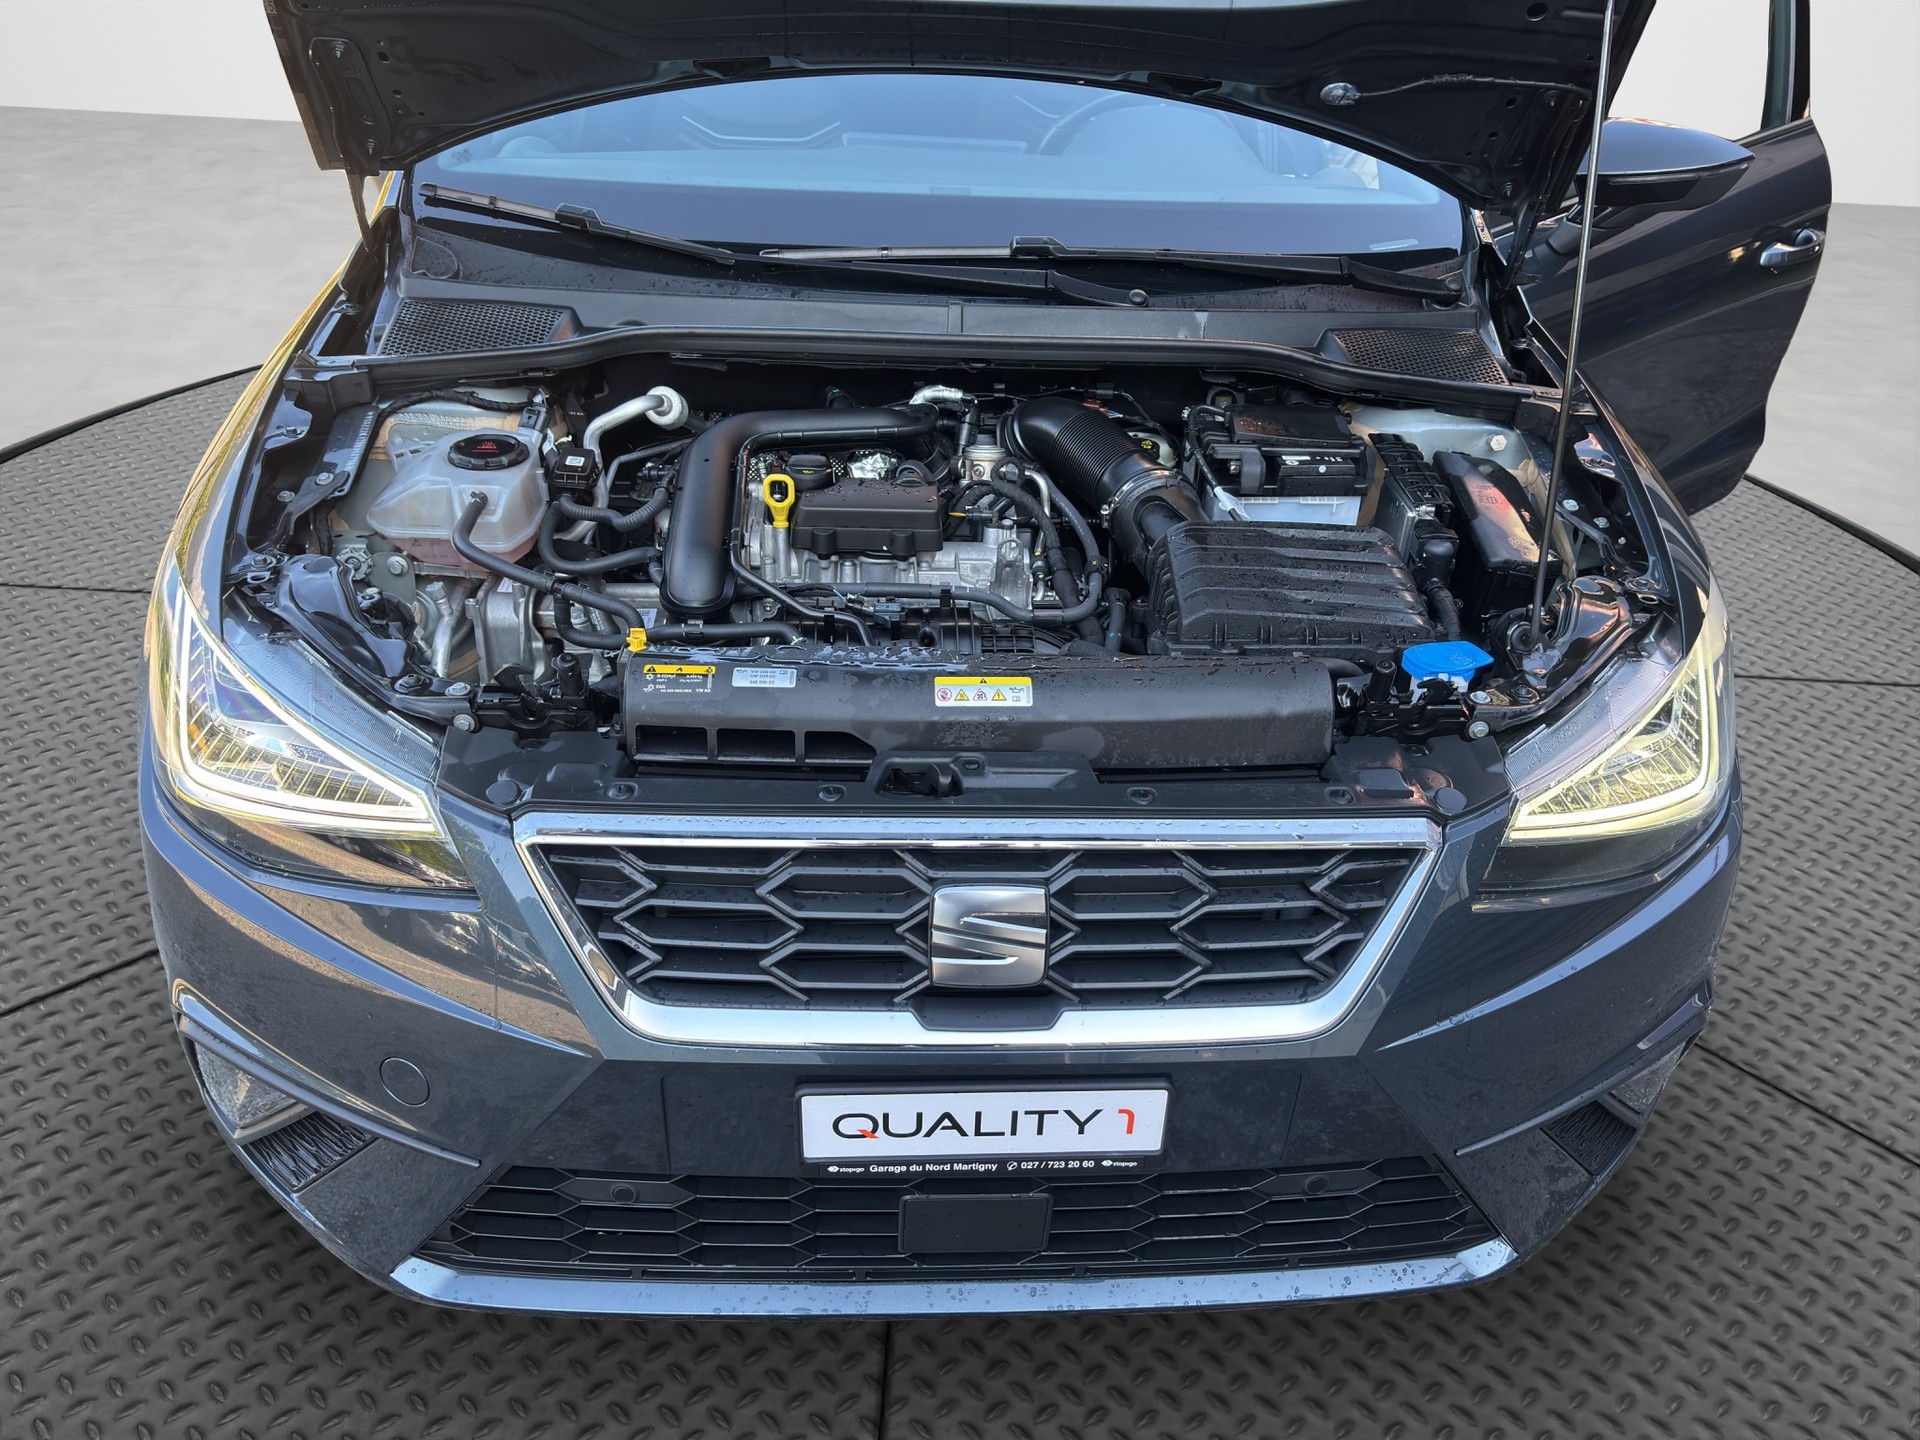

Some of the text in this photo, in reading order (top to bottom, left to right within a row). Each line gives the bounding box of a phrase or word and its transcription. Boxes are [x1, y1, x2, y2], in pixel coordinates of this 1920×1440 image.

[832, 1108, 1136, 1139] QUALITY 1
[869, 1162, 998, 1174] Garage du Nord Martigny
[1020, 1161, 1039, 1169] 027
[1048, 1160, 1066, 1168] 723
